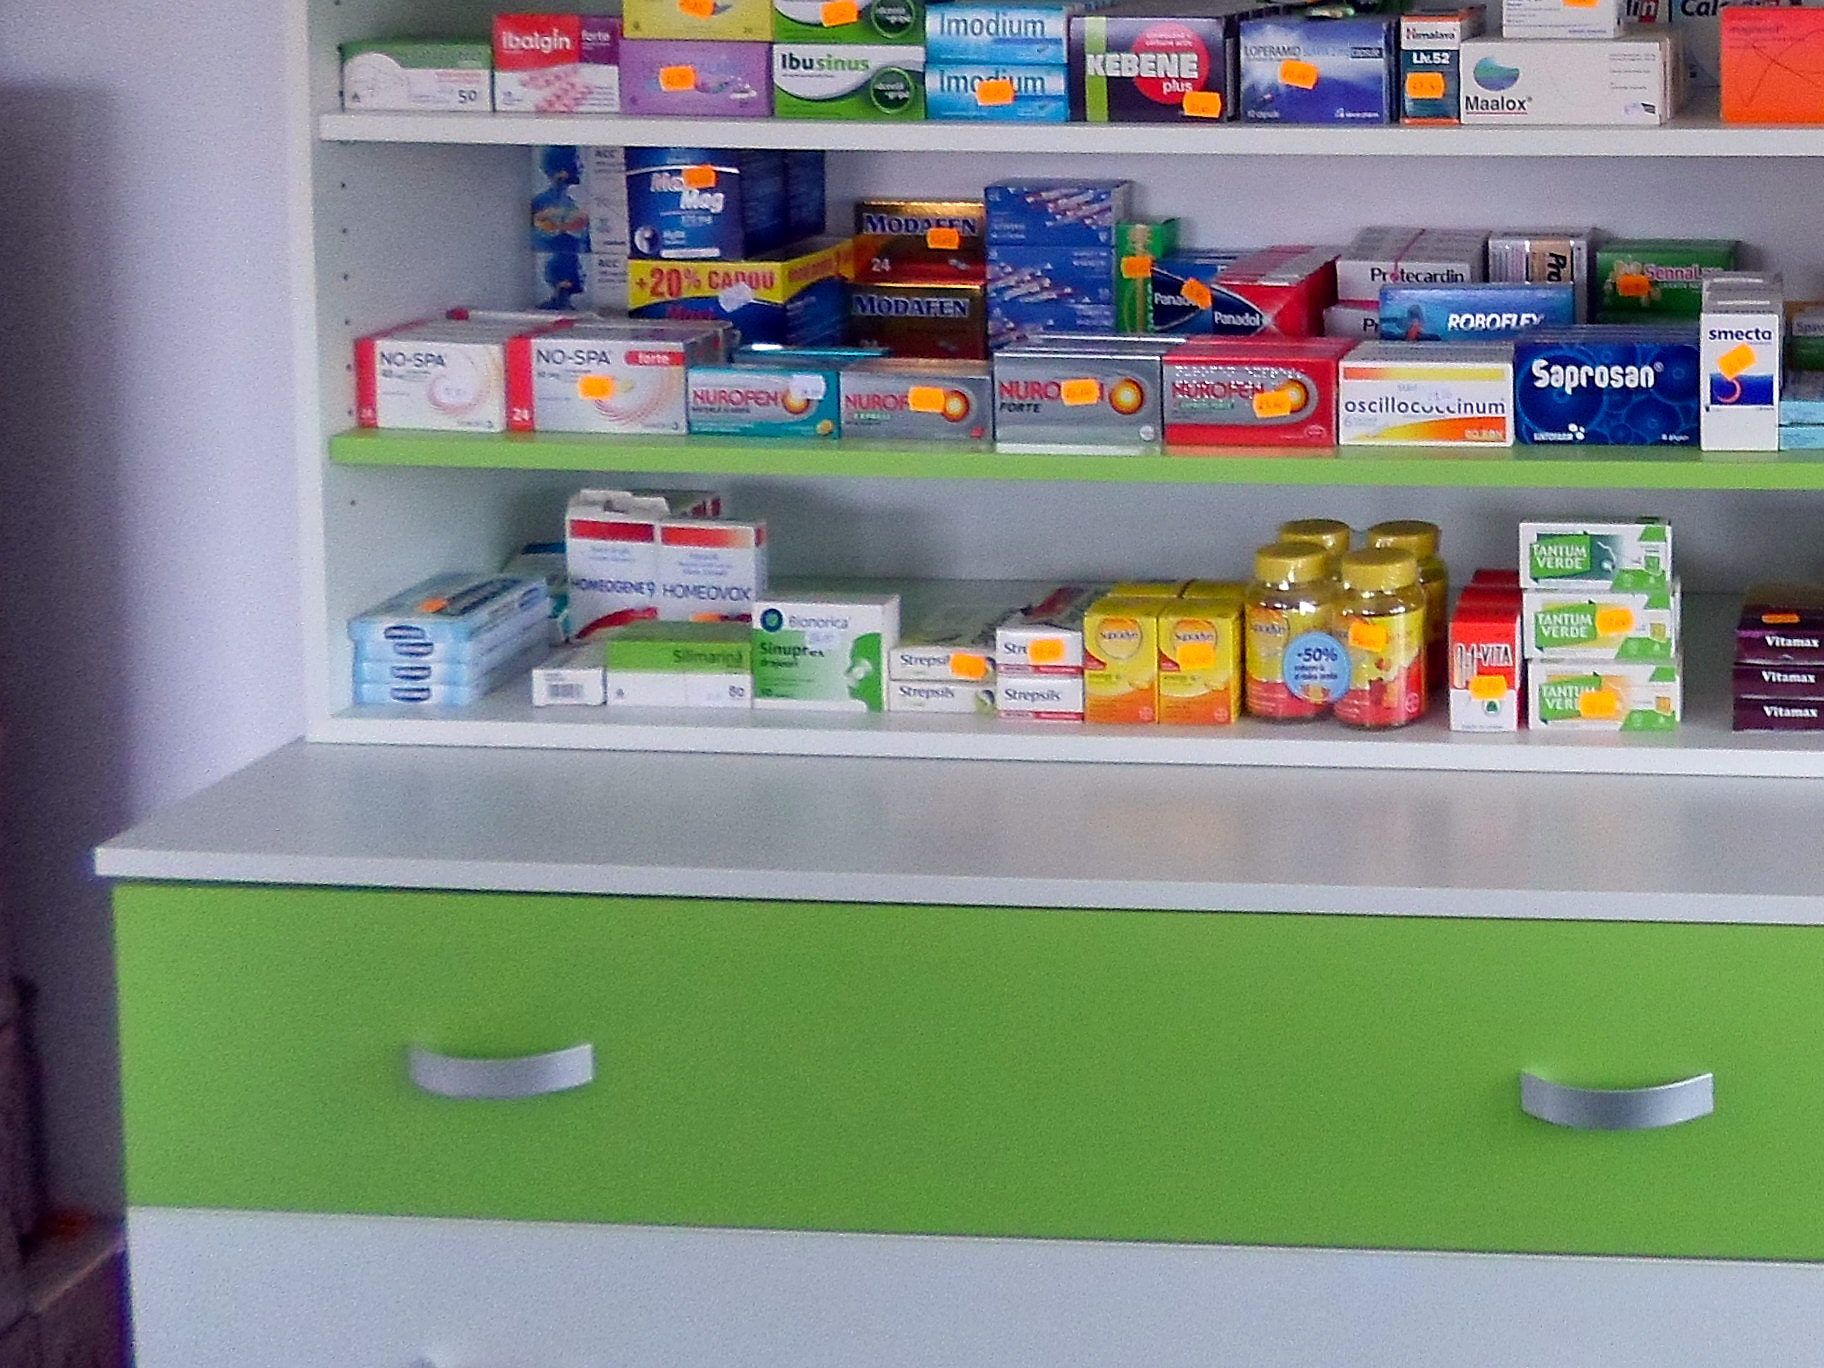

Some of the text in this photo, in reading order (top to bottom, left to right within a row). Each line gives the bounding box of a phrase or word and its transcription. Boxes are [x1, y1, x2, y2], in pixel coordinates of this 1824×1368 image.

[939, 15, 1045, 39] Imodium
[502, 32, 571, 52] ibalgin
[1244, 44, 1301, 58] LOPERAMID
[1086, 54, 1198, 78] KEBENE
[1162, 81, 1193, 95] plus
[458, 90, 477, 104] 50
[1465, 96, 1526, 112] Maalox
[866, 214, 975, 235] MODAFEN
[855, 296, 968, 316] MODAFEN
[1214, 313, 1261, 327] Panadol
[1708, 327, 1772, 342] smecta
[380, 351, 446, 369] NO-SPA
[537, 349, 610, 366] NO-SPA
[1532, 360, 1656, 394] Saprosan
[692, 389, 781, 405] NUROFEN
[1001, 403, 1041, 413] FORTE
[1532, 543, 1587, 558] TANTUM
[1537, 556, 1583, 570] VERDE
[662, 585, 750, 601] HOMEOVOX
[789, 615, 847, 630] Bionorica
[1537, 614, 1592, 629] TANTUM
[1541, 625, 1589, 638] VERDE
[1765, 636, 1819, 650] Vitamax
[1762, 672, 1815, 685] Vitamax
[900, 685, 955, 700] Strepsils
[1004, 689, 1061, 703] Strepsils
[1762, 706, 1817, 720] Vitamax
